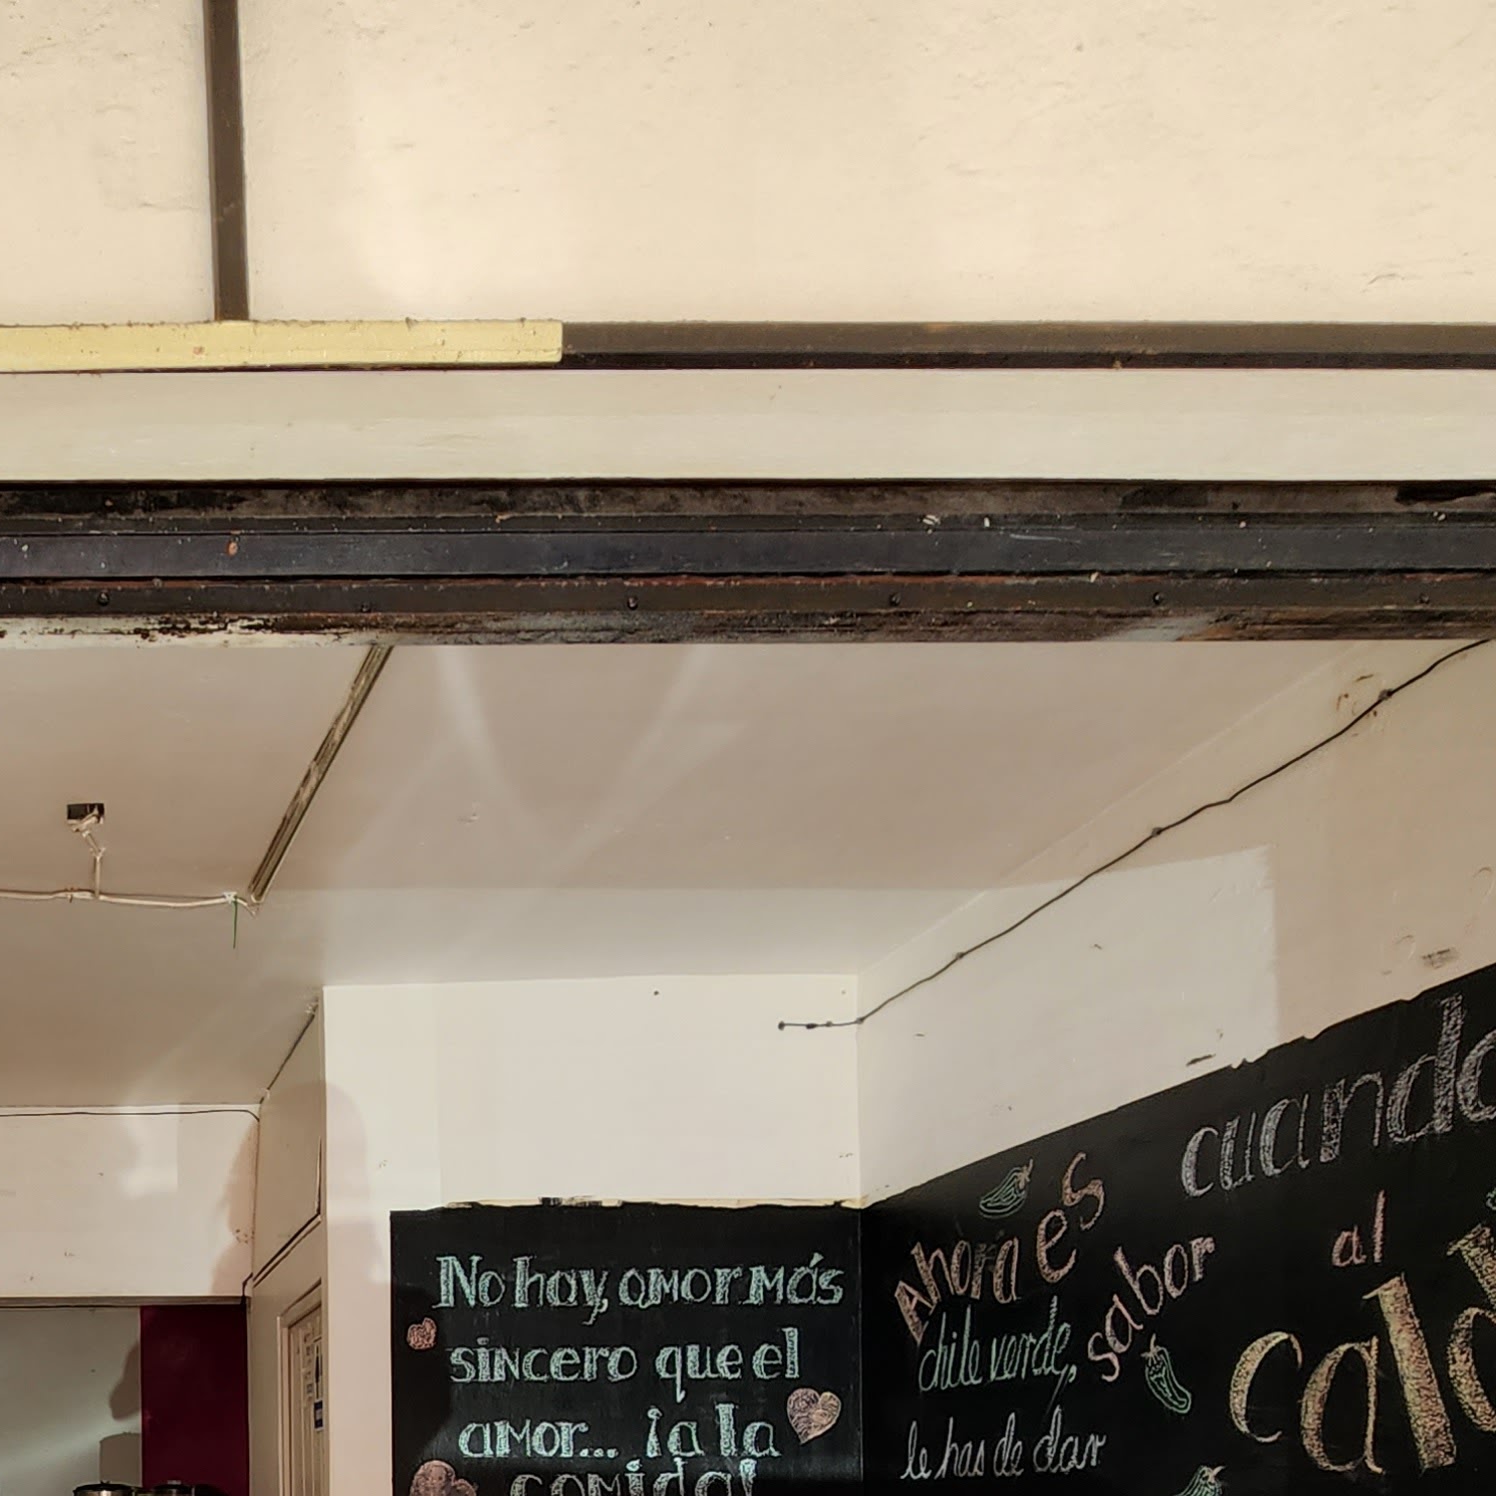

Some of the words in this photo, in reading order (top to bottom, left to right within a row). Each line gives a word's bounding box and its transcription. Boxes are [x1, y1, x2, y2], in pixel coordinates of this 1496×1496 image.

[894, 1237, 1021, 1345] Ahora
[1036, 1152, 1104, 1283] es
[1332, 1190, 1383, 1267] al
[432, 1255, 504, 1309] No
[513, 1256, 608, 1325] hay
[618, 1265, 742, 1309] amor
[738, 1252, 844, 1306] más
[1087, 1237, 1216, 1382] sabor
[449, 1337, 637, 1383] sincero
[655, 1343, 742, 1403] que
[752, 1327, 799, 1379] el
[919, 1304, 984, 1392] chile
[458, 1418, 619, 1458] amor...
[715, 1402, 781, 1458] la
[900, 1420, 933, 1479] le
[934, 1417, 985, 1478] has
[993, 1412, 1024, 1477] de
[1033, 1404, 1106, 1475] dar
